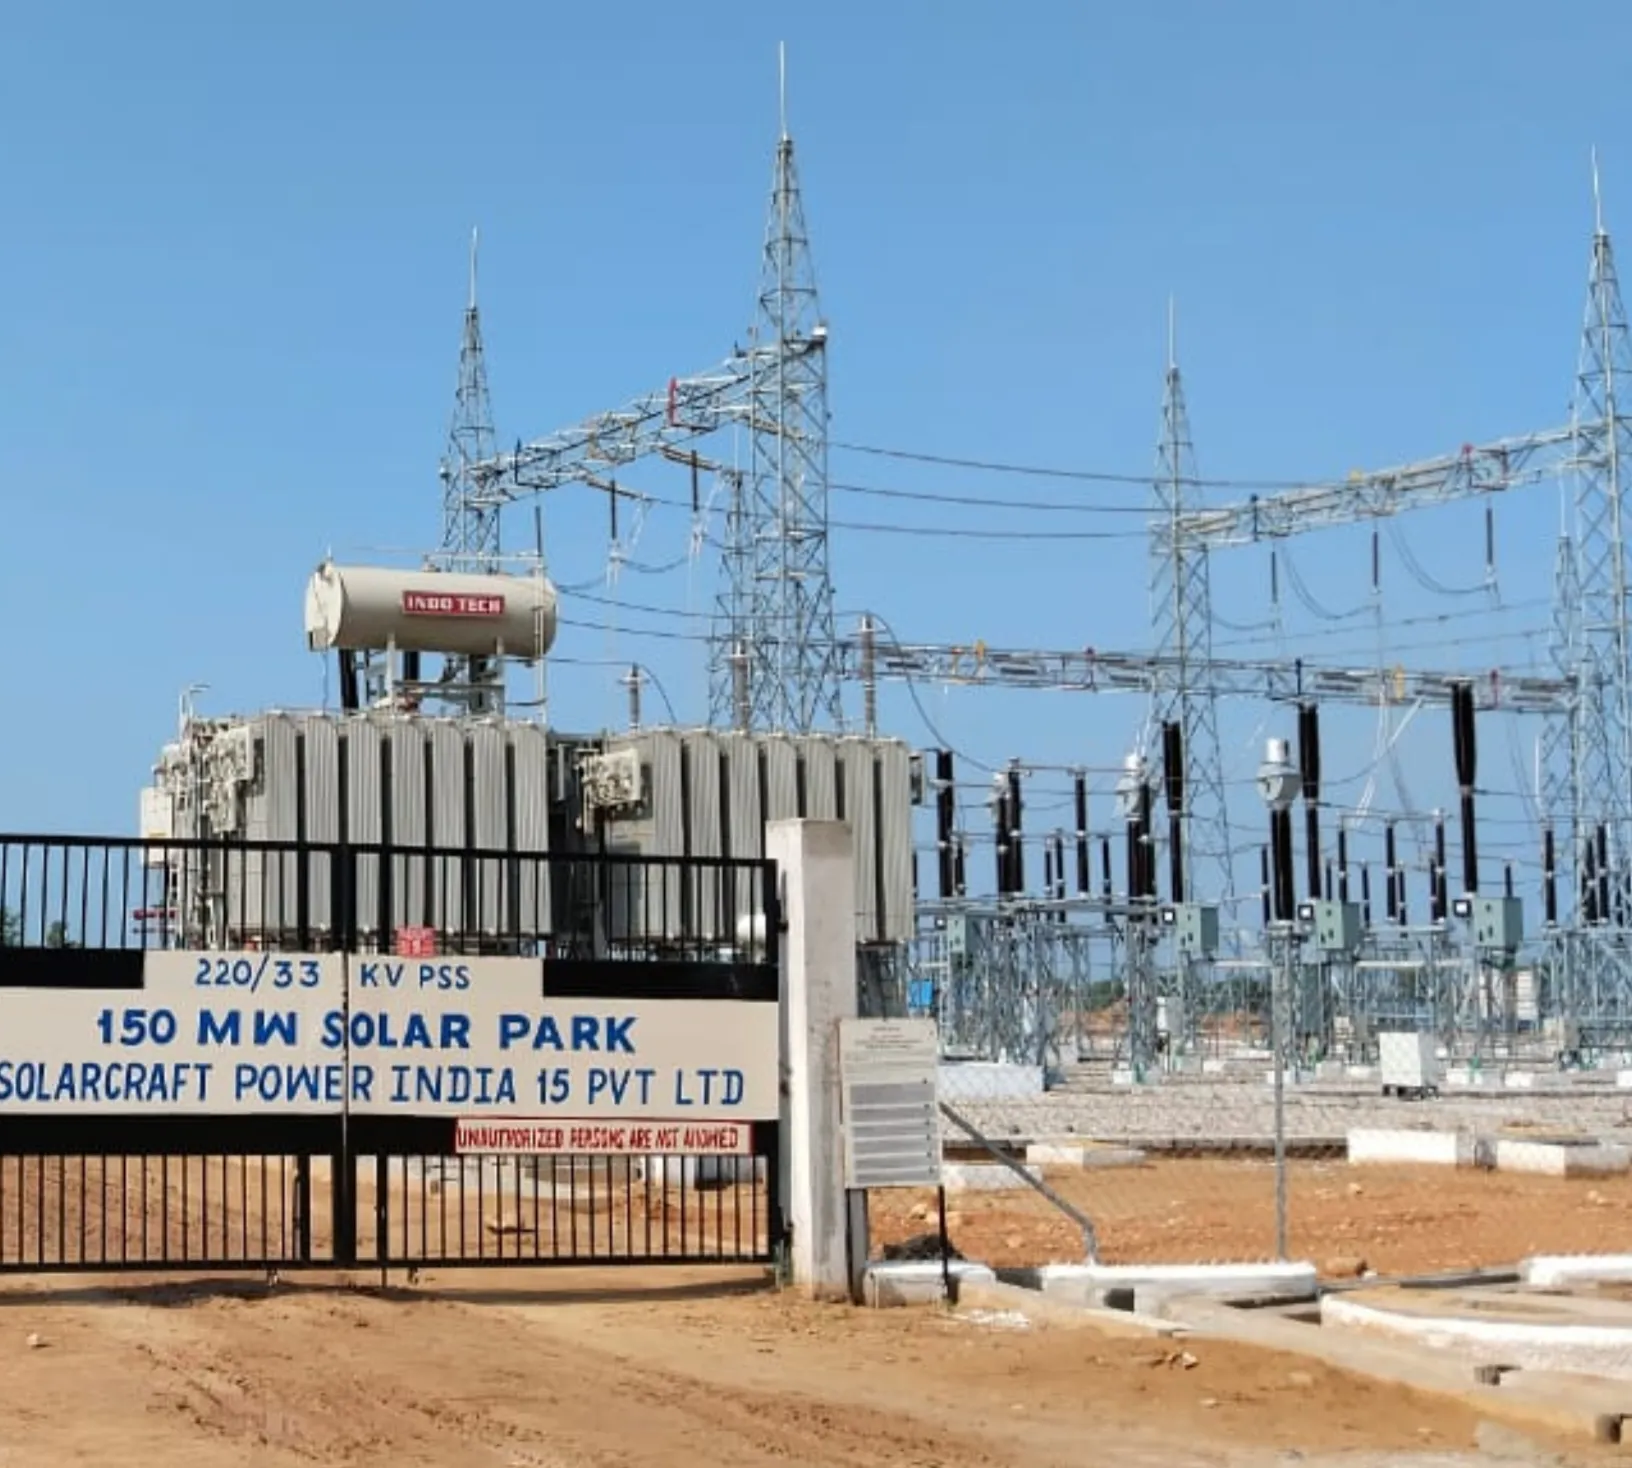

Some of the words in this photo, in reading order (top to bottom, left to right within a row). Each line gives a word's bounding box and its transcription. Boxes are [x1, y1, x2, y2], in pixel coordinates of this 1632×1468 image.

[407, 595, 452, 610] INDO
[456, 597, 501, 613] TECH
[195, 955, 320, 992] 220/33
[360, 963, 404, 989] KV
[419, 964, 471, 991] PSS
[97, 1008, 176, 1046] 150
[322, 1010, 472, 1050] SOLAR
[499, 1013, 637, 1053] PARK
[235, 1063, 375, 1103] POWER
[389, 1065, 517, 1105] INDIA
[537, 1067, 570, 1105] 15
[588, 1067, 657, 1105] PVT
[674, 1068, 745, 1106] LTD
[457, 1127, 565, 1148] UNAUTHORIZED
[570, 1127, 626, 1150] PERSONS
[629, 1127, 652, 1150] ARE
[655, 1127, 679, 1150] NOT
